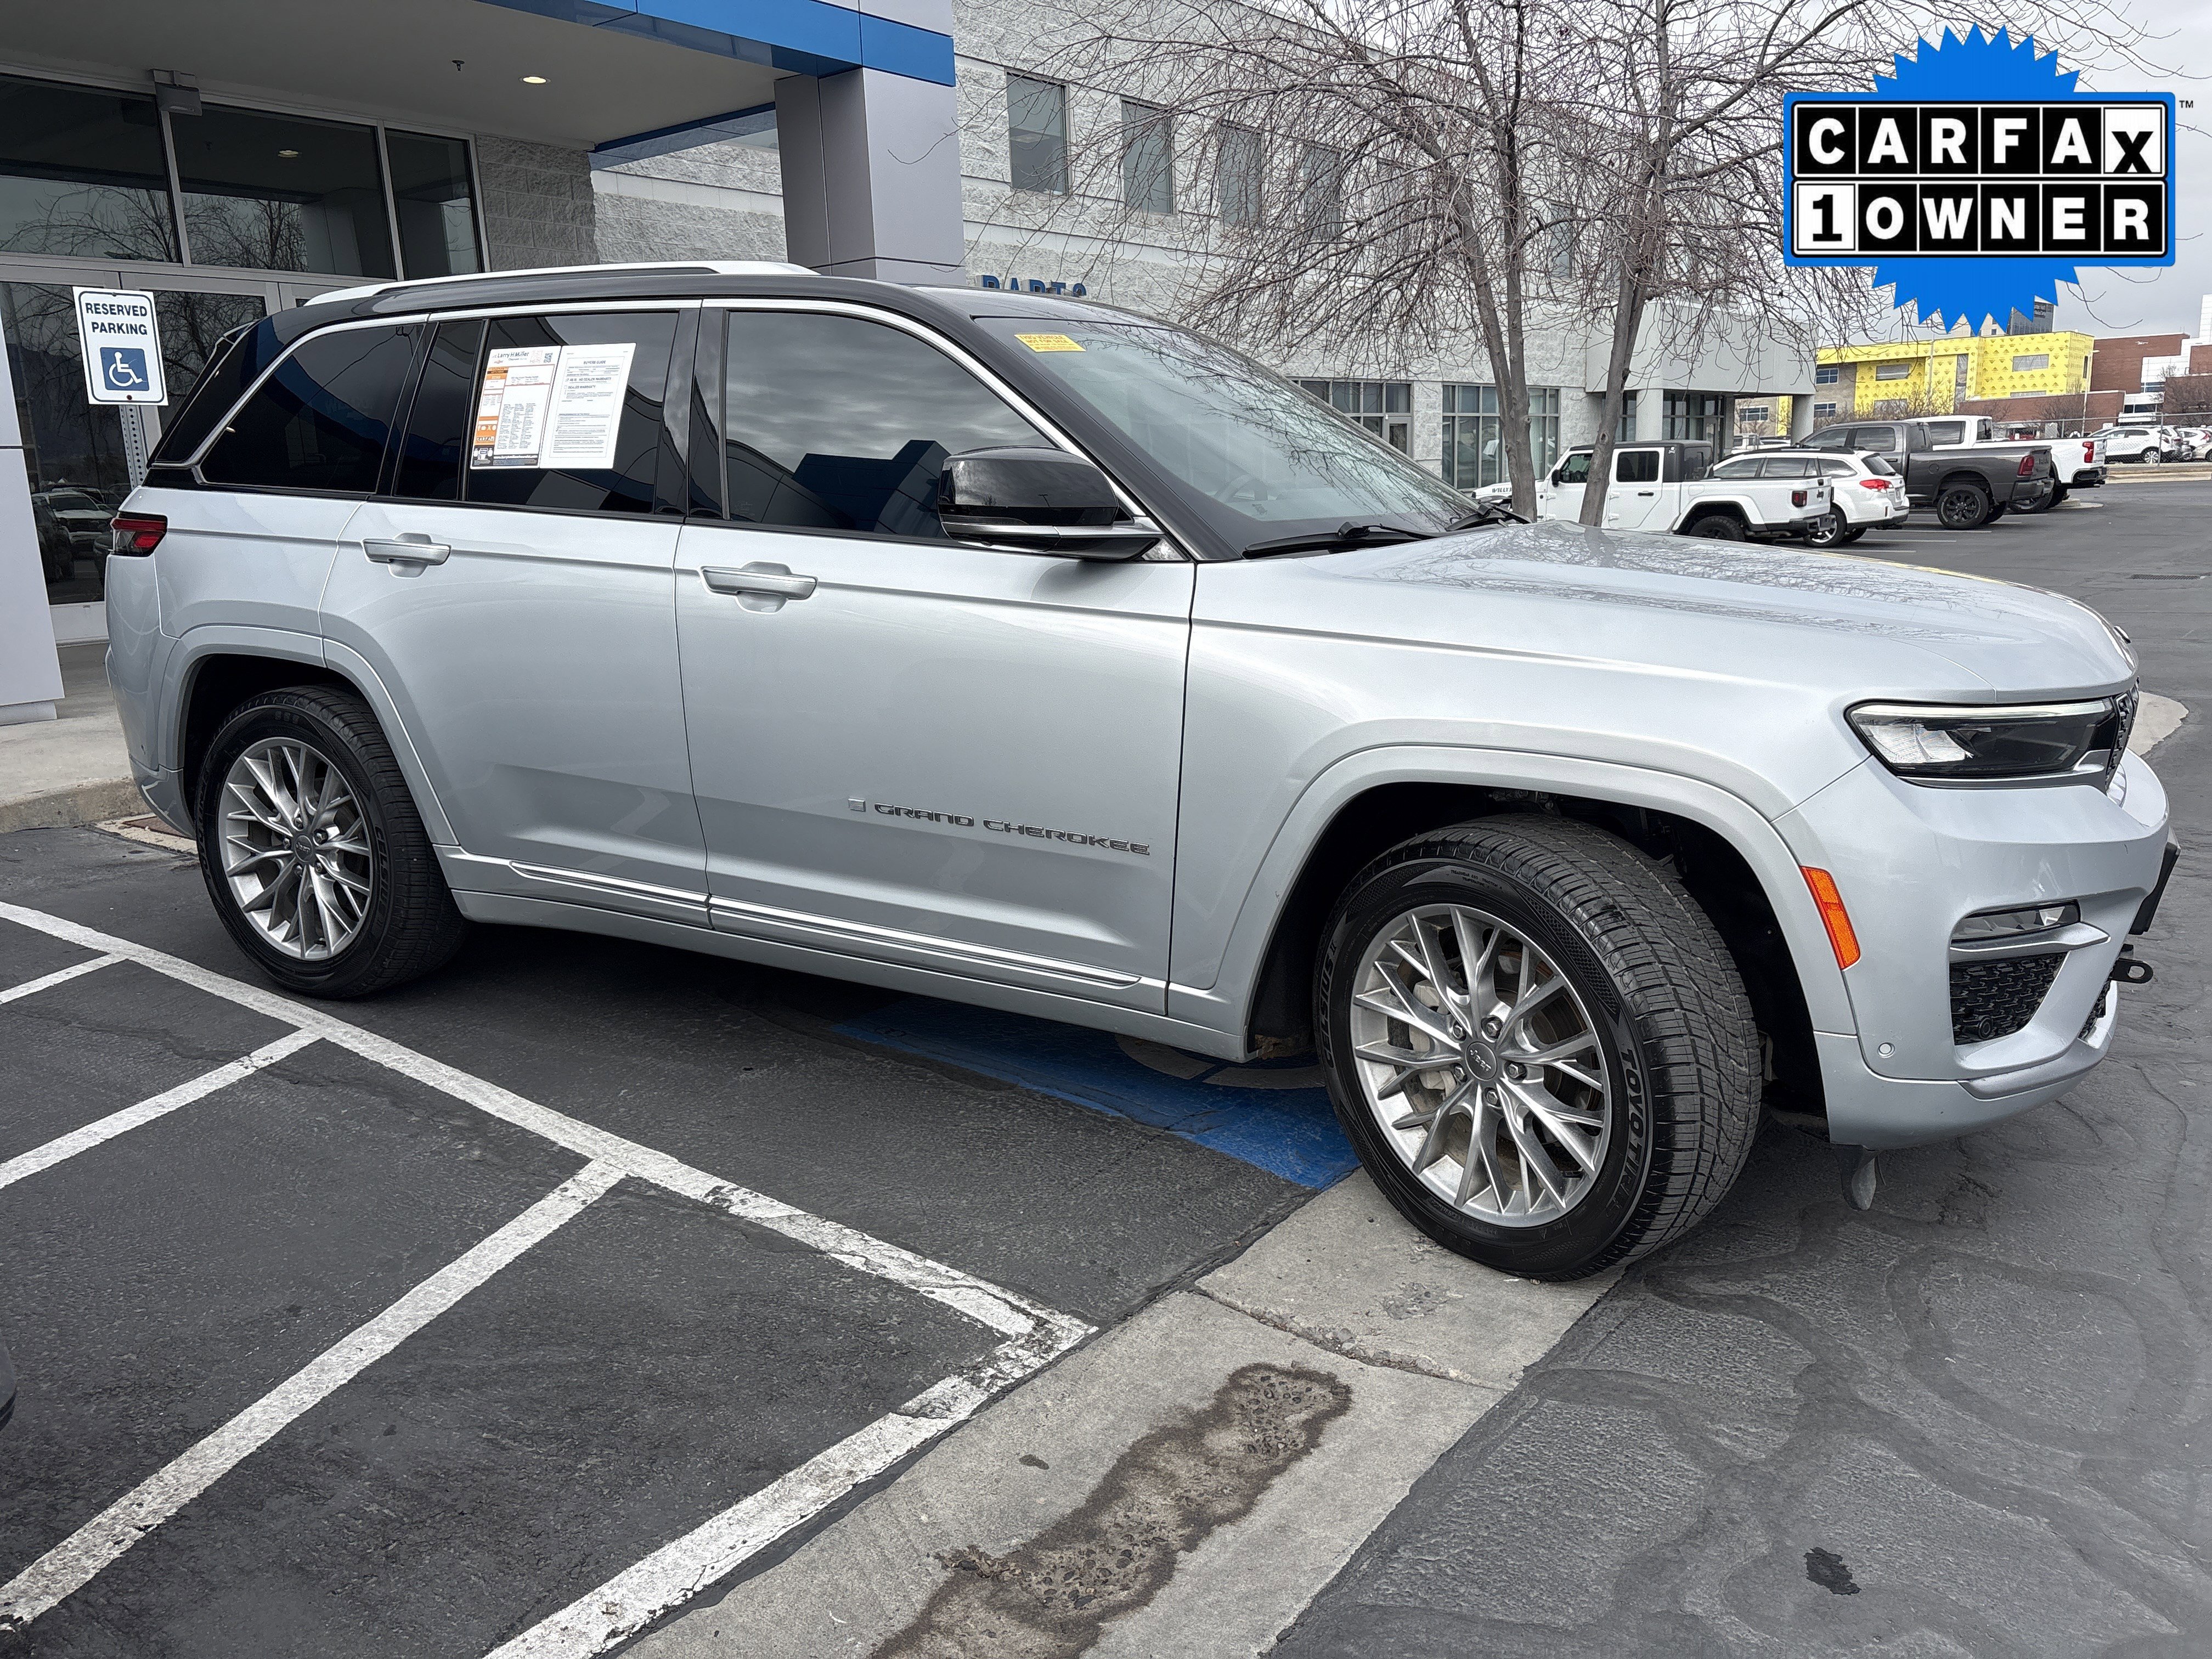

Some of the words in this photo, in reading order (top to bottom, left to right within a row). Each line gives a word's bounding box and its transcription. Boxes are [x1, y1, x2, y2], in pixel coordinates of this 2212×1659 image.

[85, 302, 148, 317] RESERVED
[91, 321, 148, 335] PARKING
[874, 803, 974, 827] GRAND
[983, 819, 1150, 856] CHEROKEE
[1320, 953, 1334, 1069] CELSIUS
[1470, 1049, 1492, 1072] Jeep
[1620, 1048, 1644, 1139] TOYO
